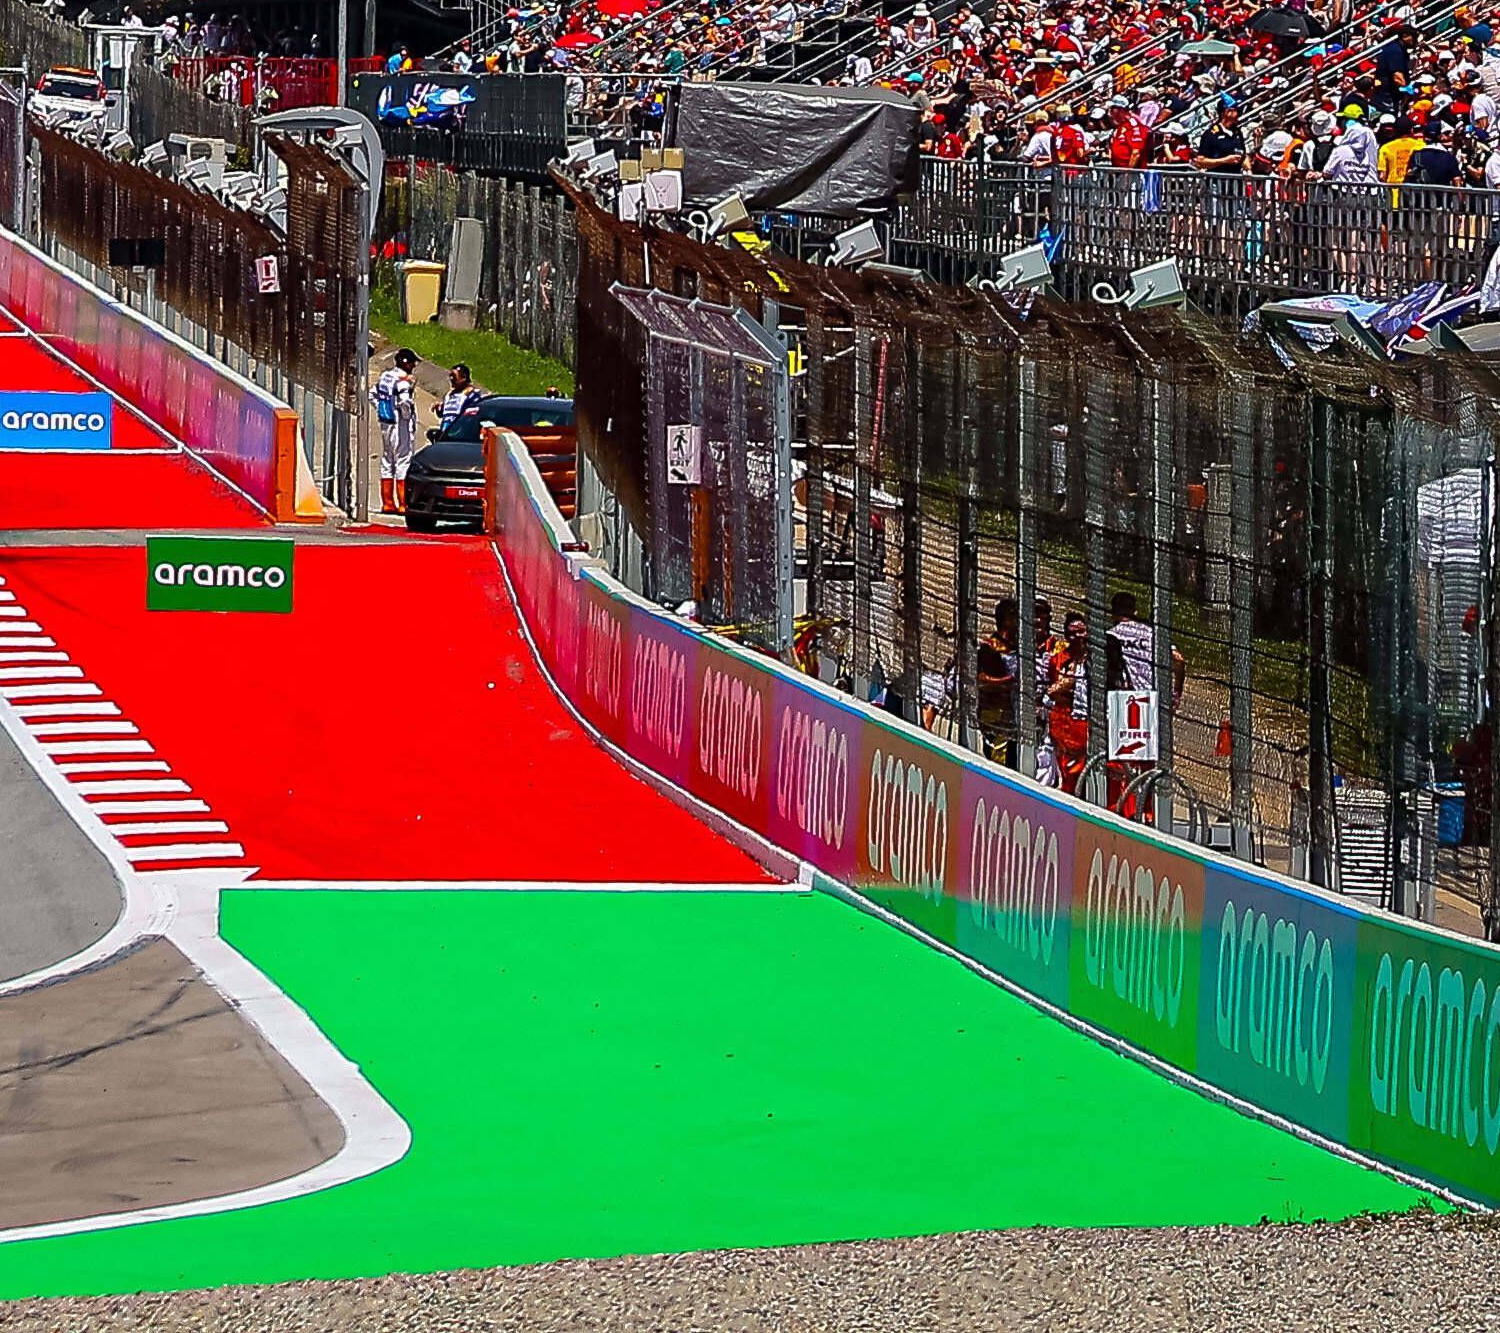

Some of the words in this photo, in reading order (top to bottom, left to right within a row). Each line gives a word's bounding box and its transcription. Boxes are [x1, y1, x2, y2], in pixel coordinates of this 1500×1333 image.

[2, 411, 104, 432] aramco
[154, 563, 285, 589] aramco
[700, 666, 762, 802] aramco
[777, 705, 847, 845] aramco
[868, 748, 947, 907] aramco
[971, 798, 1058, 966] aramco
[1085, 848, 1185, 1028] aramco
[1216, 900, 1334, 1095] aramco
